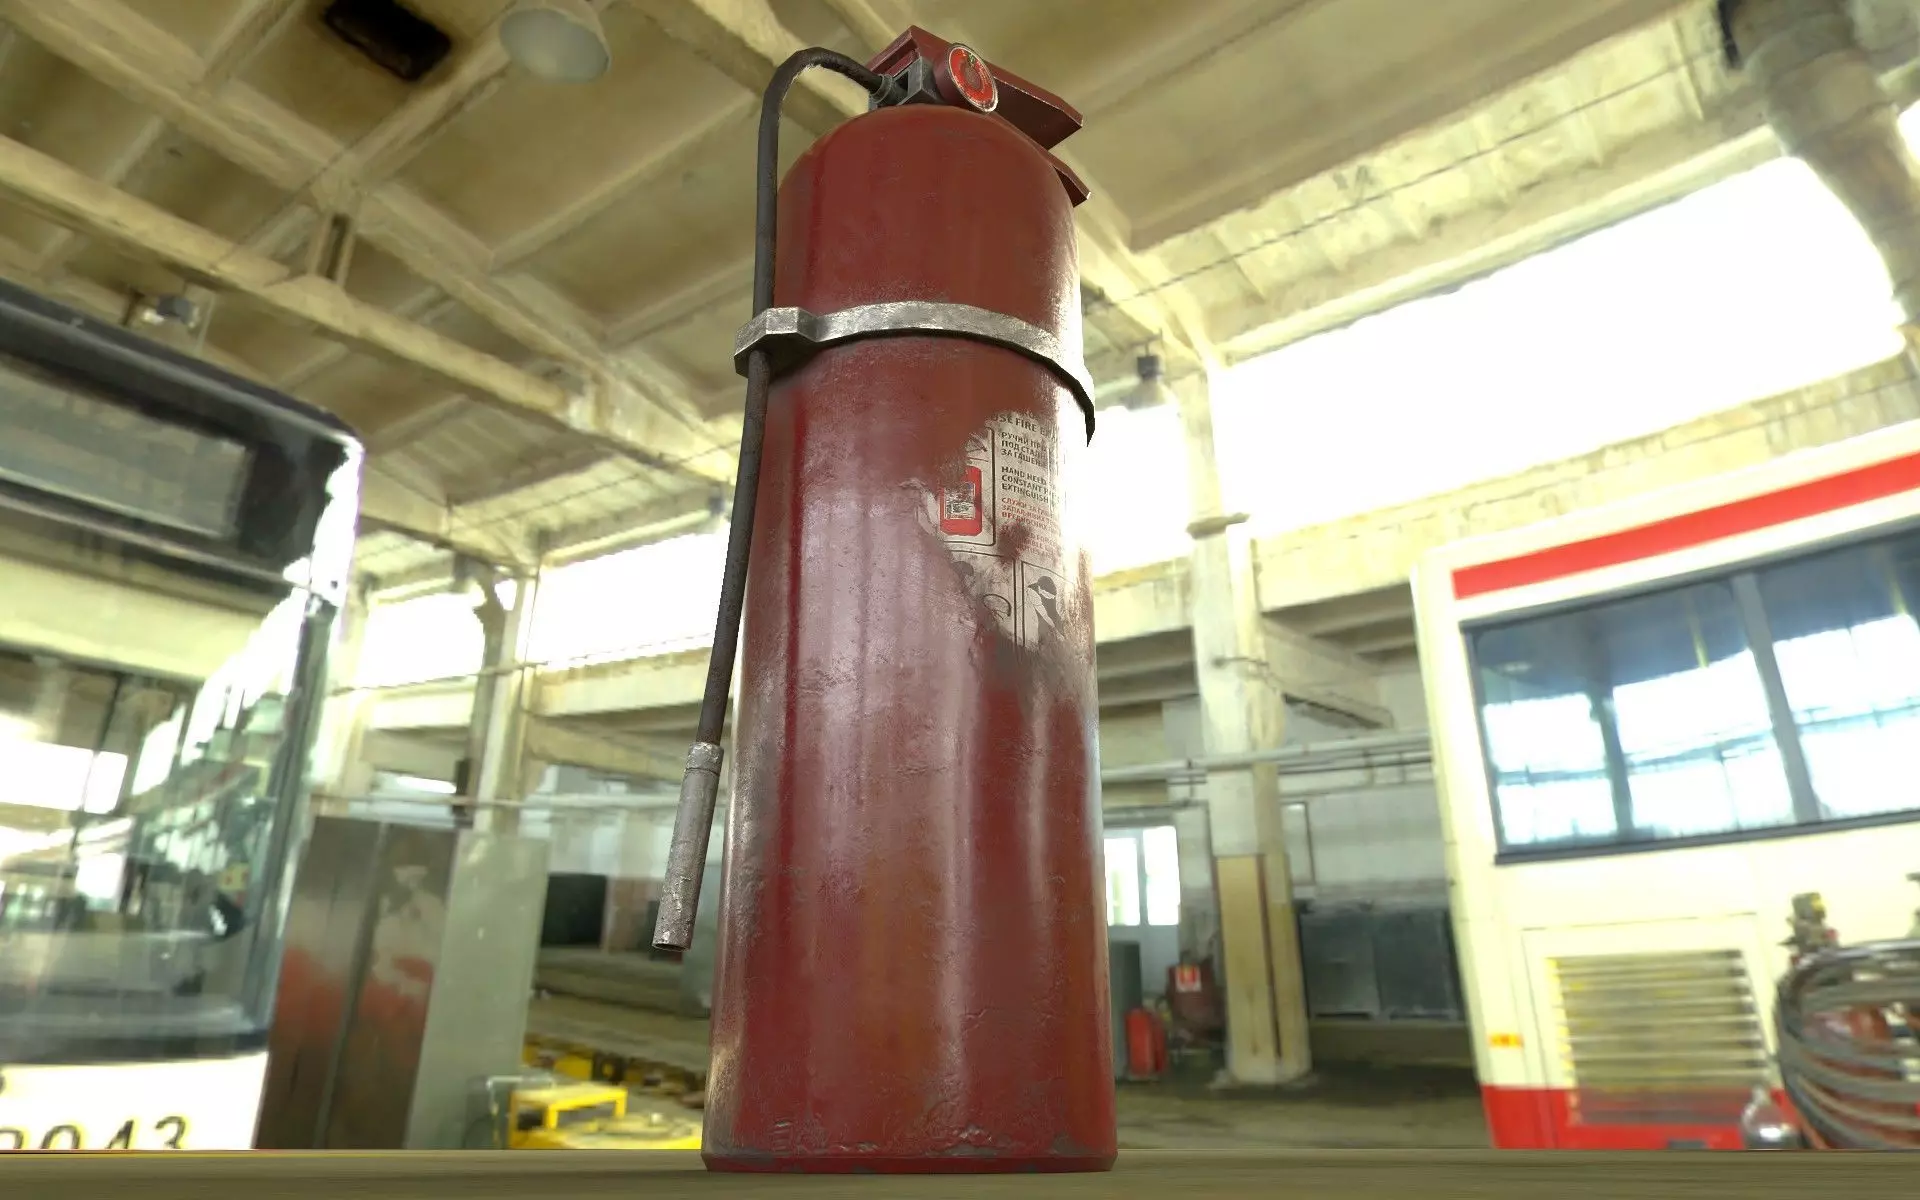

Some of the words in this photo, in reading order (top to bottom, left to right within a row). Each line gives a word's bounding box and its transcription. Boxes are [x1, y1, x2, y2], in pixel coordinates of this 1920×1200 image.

[1015, 417, 1038, 433] FIRE
[1001, 466, 1025, 478] HAND
[1001, 474, 1043, 492] CONSTANT
[1001, 483, 1050, 504] EXTINGUISH
